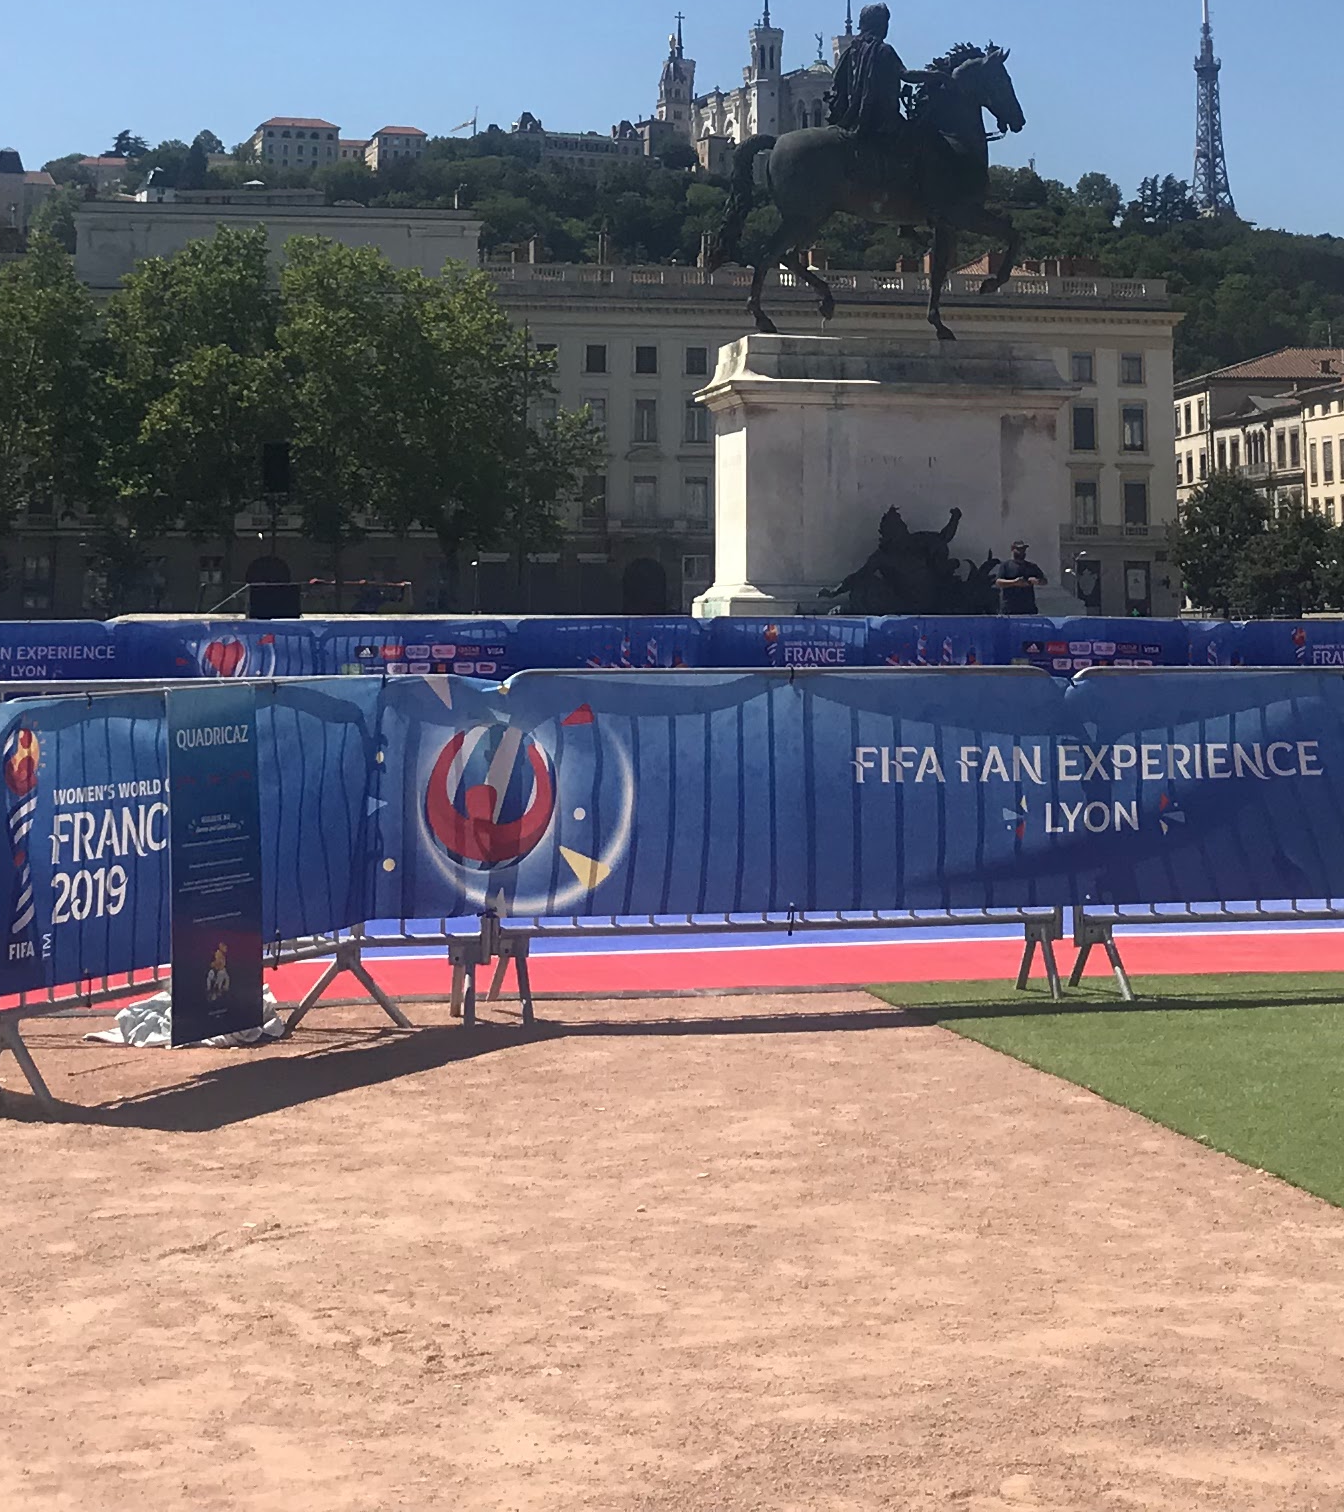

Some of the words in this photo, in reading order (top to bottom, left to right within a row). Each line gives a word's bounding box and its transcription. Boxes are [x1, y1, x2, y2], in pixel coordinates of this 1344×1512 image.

[16, 645, 116, 660] EXPERIENCE
[784, 647, 846, 664] FRANCE
[10, 665, 47, 678] LYON
[176, 724, 249, 751] QUADRICAZ
[850, 745, 946, 785] FIFA
[956, 744, 1047, 785] FAN
[1057, 740, 1324, 781] EXPERIENCE
[118, 778, 161, 798] WORLD
[1044, 800, 1140, 833] LYON
[48, 802, 170, 865] FRANC
[50, 865, 129, 925] 2019
[8, 941, 35, 961] FIFA
